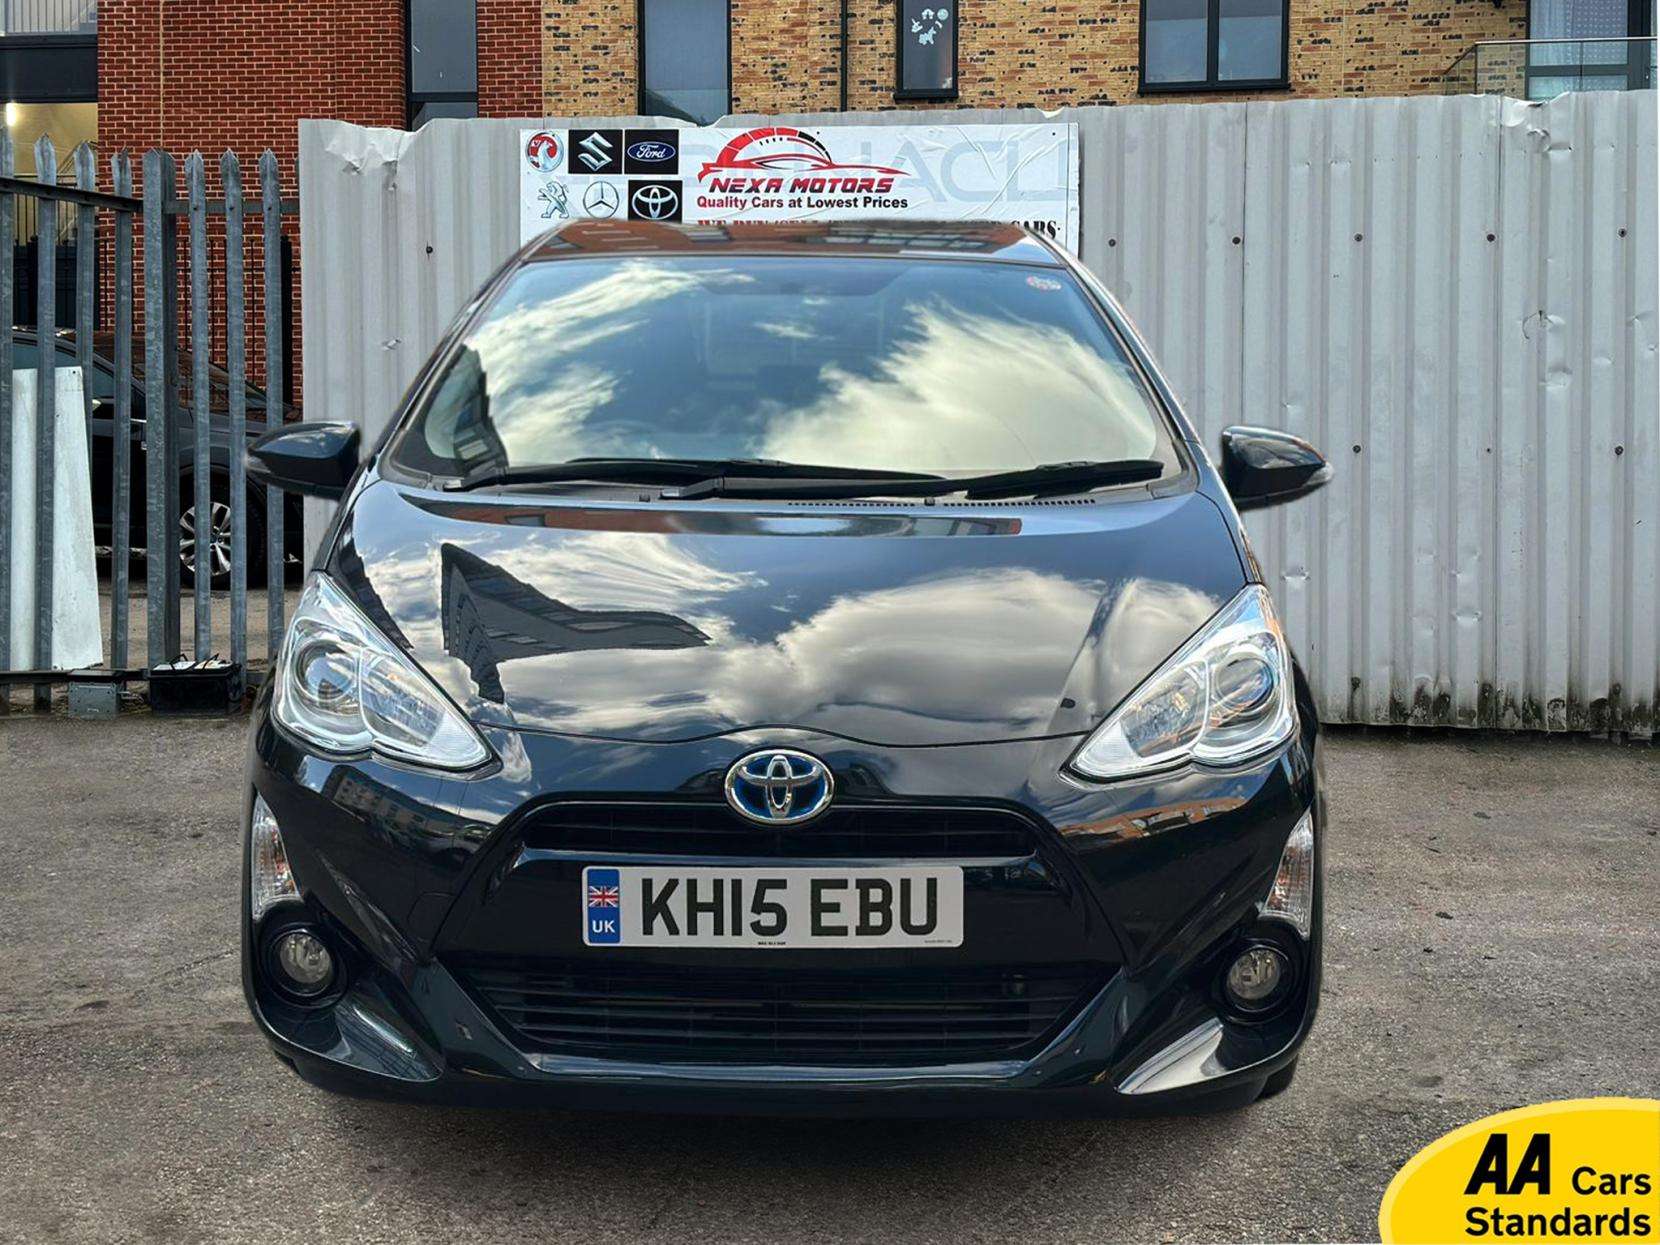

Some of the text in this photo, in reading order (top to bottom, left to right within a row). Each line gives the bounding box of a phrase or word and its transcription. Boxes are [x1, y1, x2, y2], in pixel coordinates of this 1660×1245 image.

[636, 144, 666, 158] Ford
[709, 178, 894, 193] NEXA MOTORS
[697, 196, 909, 210] Quality Cars at Lowest Prices
[641, 877, 938, 937] KH15 EBU
[592, 919, 616, 933] UK
